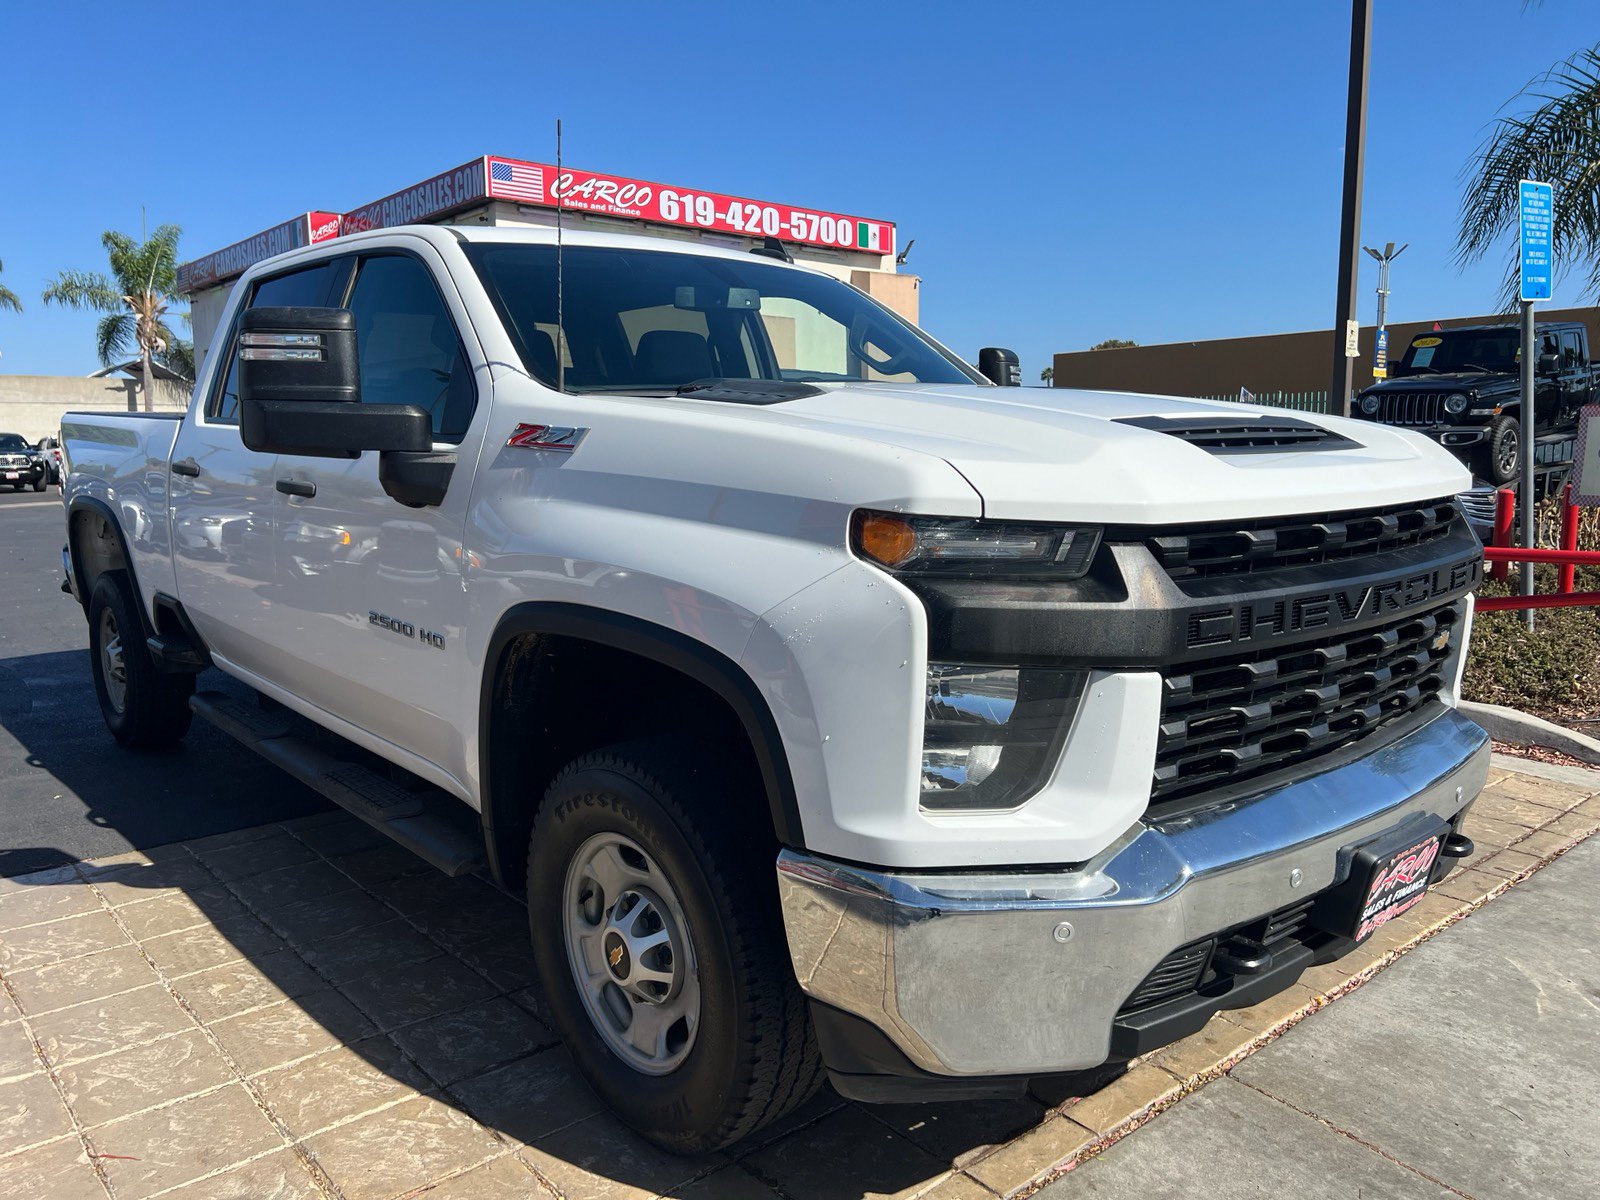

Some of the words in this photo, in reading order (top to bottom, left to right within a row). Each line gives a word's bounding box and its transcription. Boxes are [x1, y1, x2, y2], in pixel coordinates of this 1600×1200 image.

[382, 162, 484, 228] CARCOSALES.COM
[550, 173, 652, 208] CARCO
[563, 198, 588, 209] Sales
[590, 203, 607, 211] and
[608, 205, 641, 216] Finance
[311, 219, 339, 241] CARCO
[659, 189, 853, 246] 619-420-5700
[214, 224, 291, 277] CARCOSALES.COM
[1187, 556, 1482, 649] CHEVROLET
[368, 610, 415, 639] 2500
[420, 627, 446, 651] HD
[1360, 897, 1386, 921] SALES
[1392, 876, 1428, 902] FINANCE
[1364, 841, 1439, 907] CARCO
